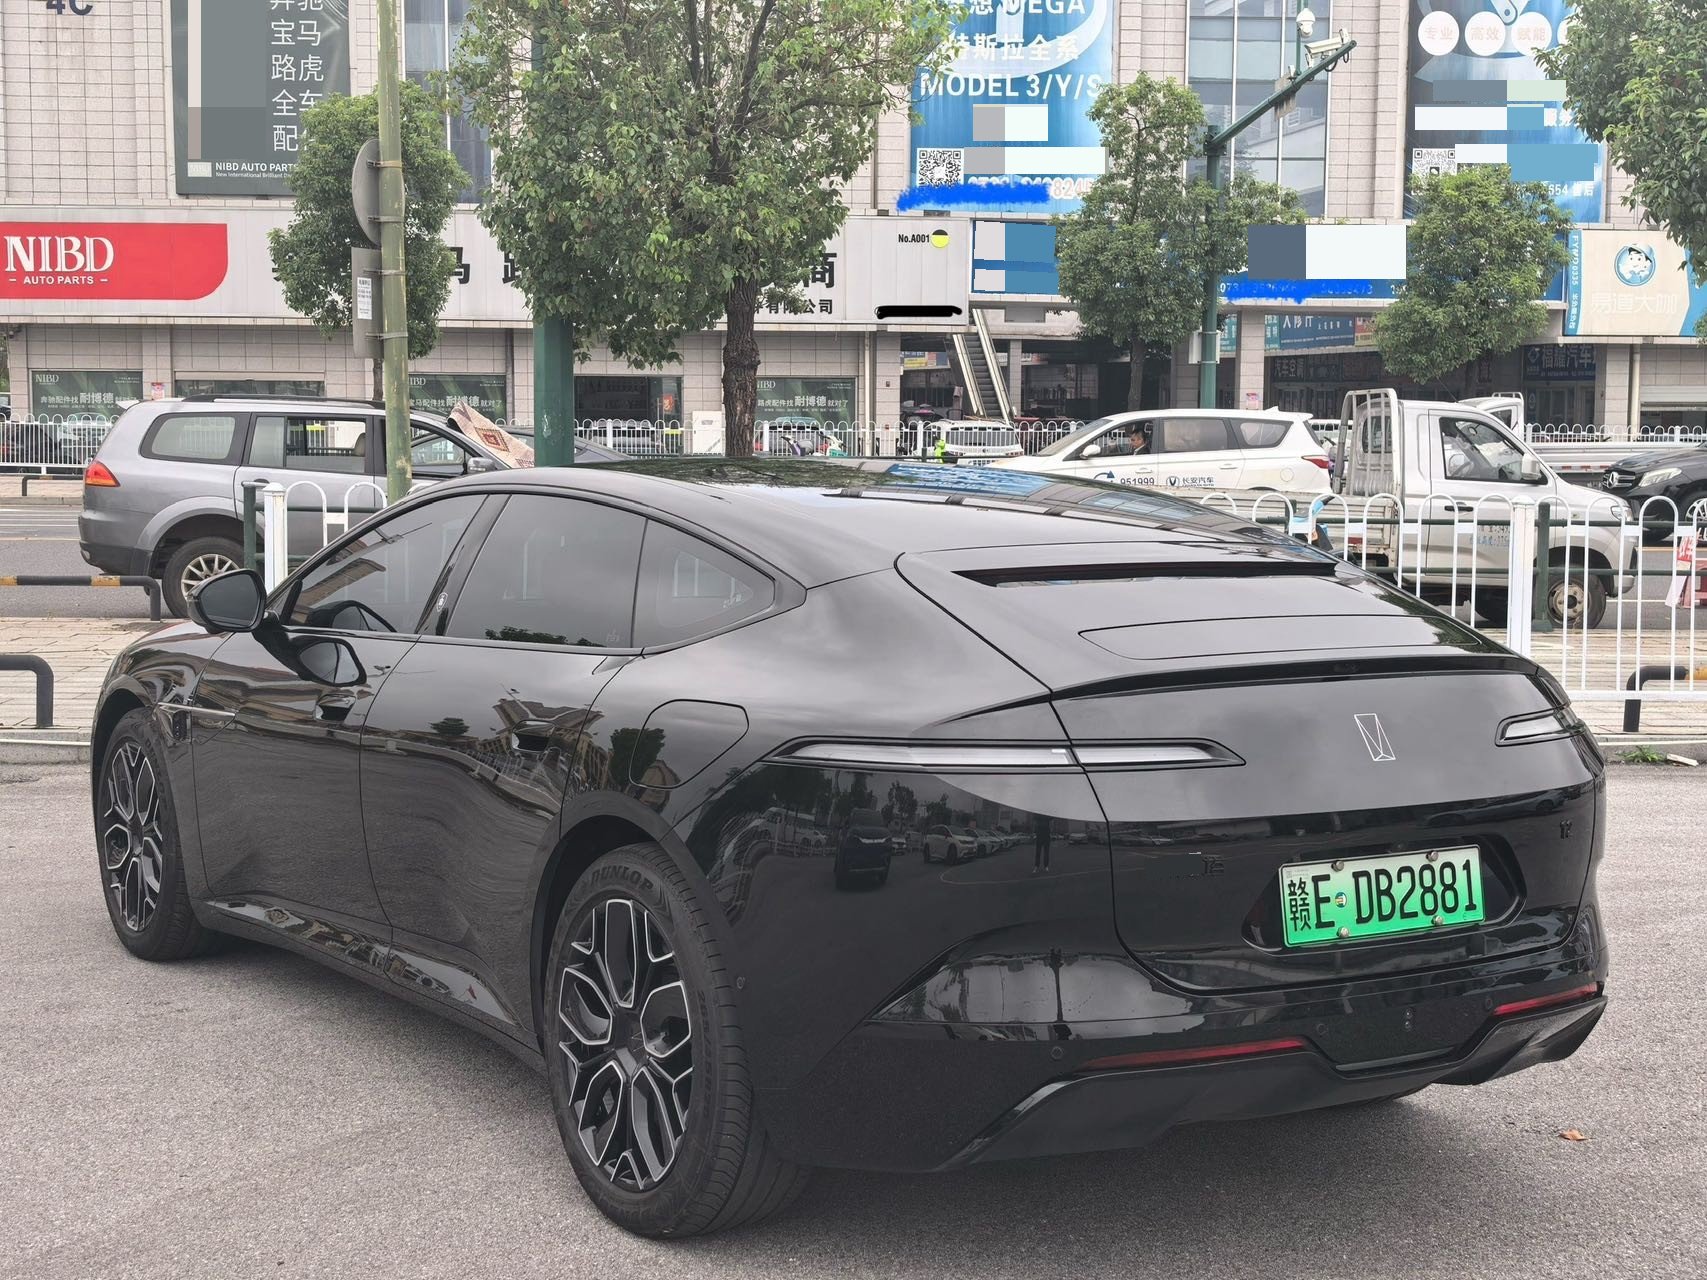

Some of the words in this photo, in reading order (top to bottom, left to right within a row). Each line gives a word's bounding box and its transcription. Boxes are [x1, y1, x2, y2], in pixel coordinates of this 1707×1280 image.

[271, 19, 321, 46] 宝马
[1425, 26, 1453, 40] 专业
[1471, 27, 1500, 41] 高效
[1517, 28, 1545, 41] 赋能
[271, 54, 324, 82] 路虎
[920, 73, 1019, 97] MODEL
[215, 162, 239, 171] NIBD
[241, 162, 267, 172] AUTO
[898, 234, 930, 244] No.A001
[3, 236, 115, 272] NIBD
[23, 275, 55, 285] AUTO
[57, 275, 95, 285] PARTS
[1542, 344, 1596, 369] 福耀汽车
[35, 374, 60, 383] NIBD
[410, 377, 427, 386] IBD
[1120, 477, 1155, 486] 951999
[592, 865, 654, 892] DUNLOP
[1287, 874, 1335, 932] 赣E
[1352, 858, 1477, 925] DB2881
